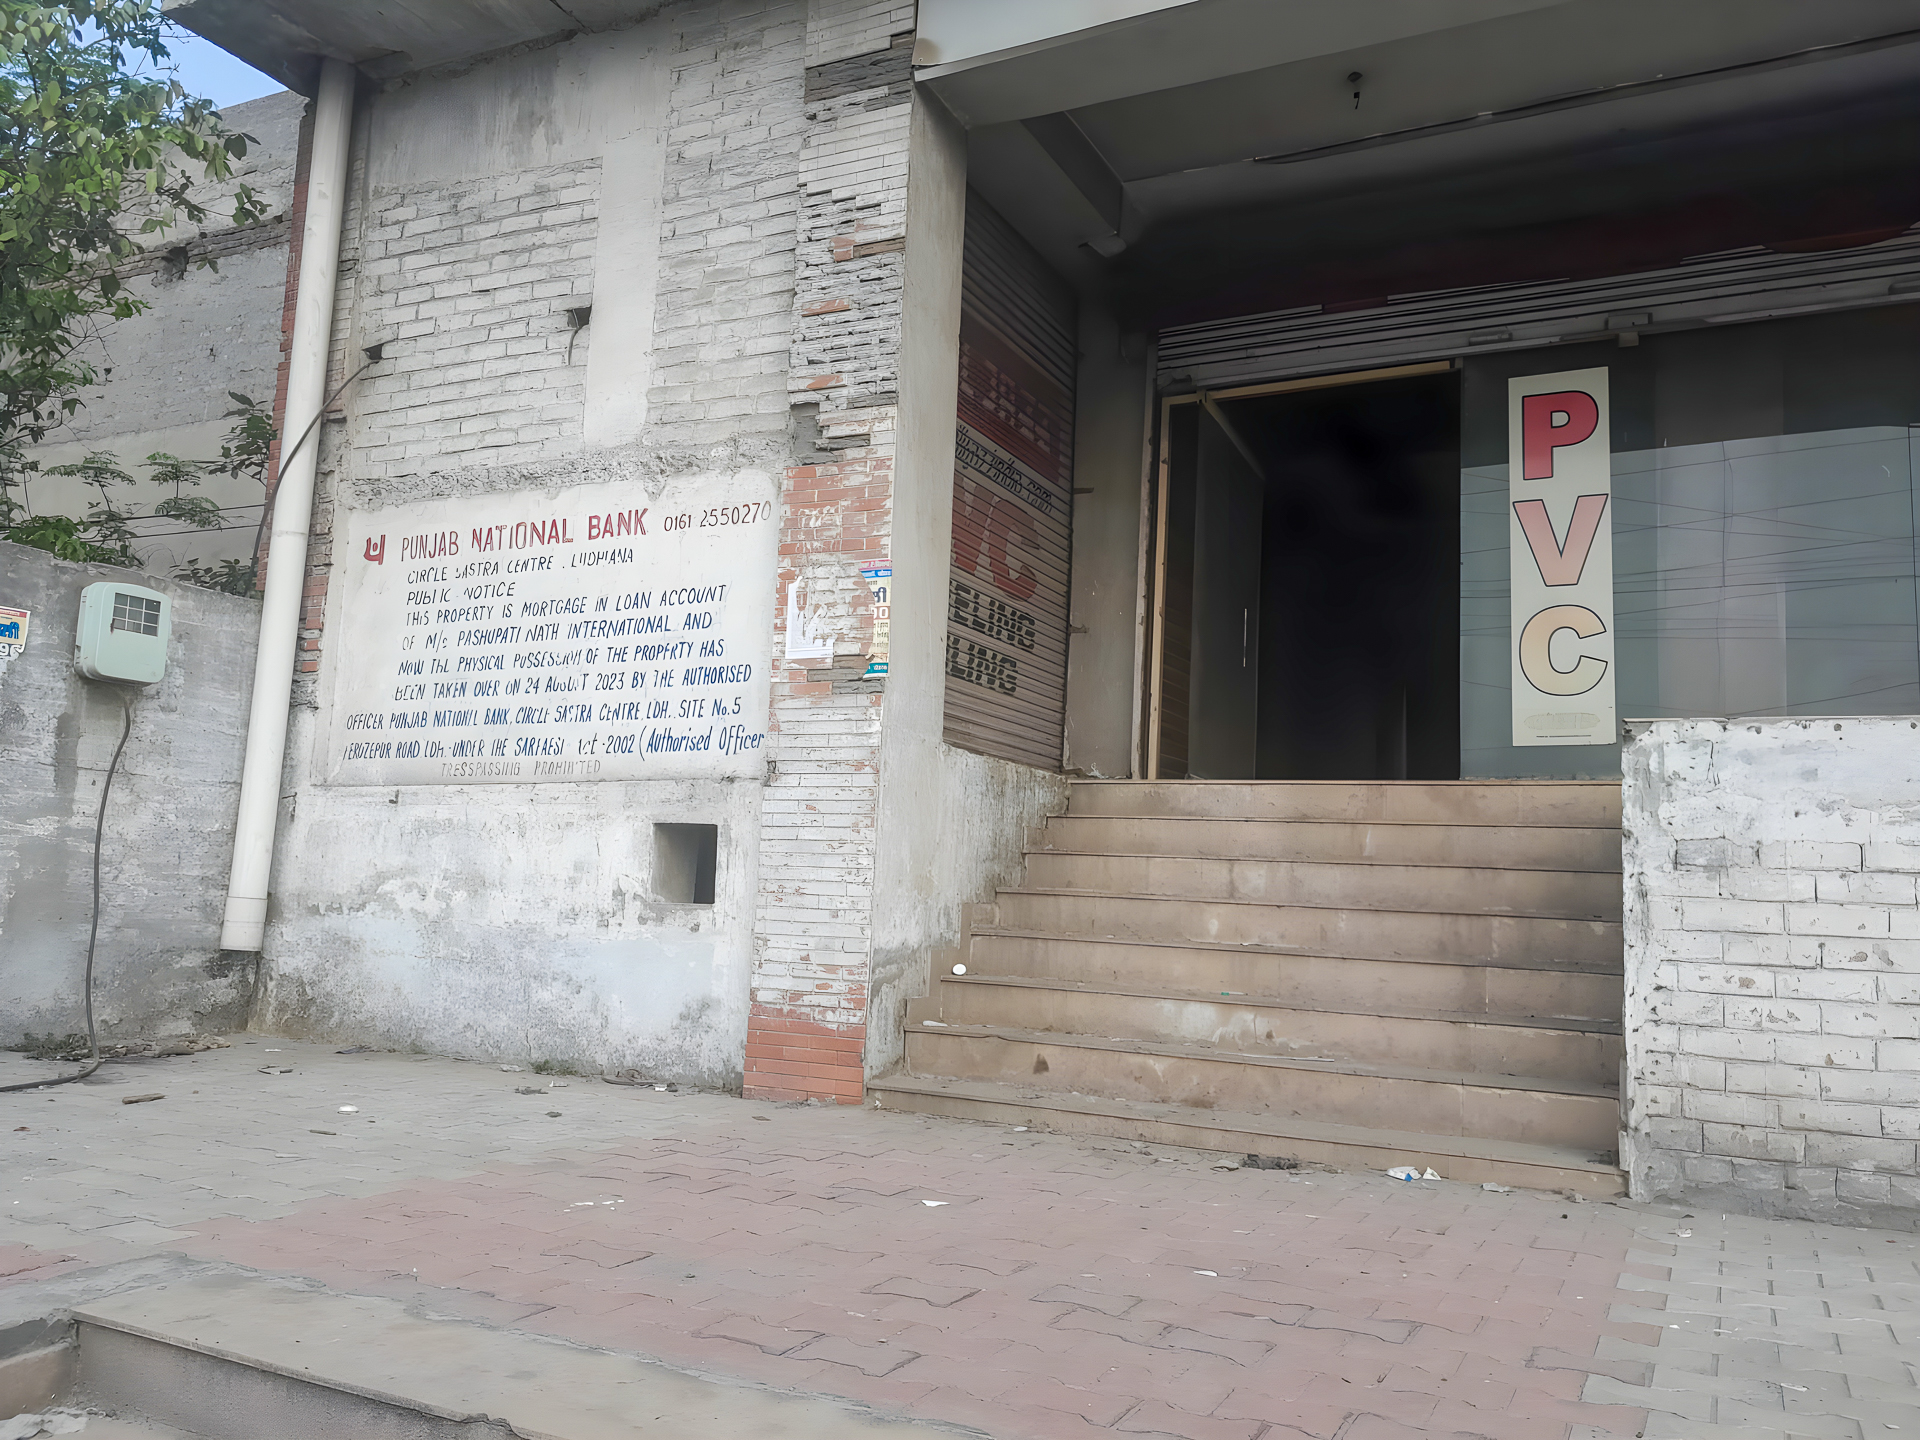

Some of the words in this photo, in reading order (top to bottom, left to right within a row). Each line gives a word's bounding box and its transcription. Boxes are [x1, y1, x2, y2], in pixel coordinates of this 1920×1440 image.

[401, 531, 459, 562] PUNJAB
[472, 518, 573, 552] NATIONAL
[588, 508, 648, 541] BANK
[664, 514, 692, 532] 0161
[700, 500, 772, 528] 2550270
[407, 567, 447, 584] CIRCLE
[507, 555, 554, 574] CENTRE
[407, 611, 429, 626] THIS
[437, 605, 494, 623] PROPERTY
[502, 603, 513, 618] IS
[521, 597, 587, 618] MORTGAGE
[595, 597, 608, 612] IN
[616, 592, 652, 612] LOAN
[659, 584, 726, 606] ACCOUNT
[464, 582, 515, 600] NOTICE
[402, 635, 415, 650] OF
[457, 626, 521, 646] PASHUPATI
[525, 623, 560, 642] NATH
[568, 615, 671, 639] INTERNATIONAL
[683, 612, 712, 630] AND
[398, 659, 424, 675] NOW
[457, 655, 505, 672] PHYSICAL
[586, 647, 599, 664] OF
[607, 646, 628, 662] THE
[634, 641, 693, 661] PROPERTY
[700, 639, 724, 657] HAS
[434, 682, 467, 698] TAKEN
[474, 680, 500, 697] OVER
[505, 678, 521, 695] ON
[525, 677, 540, 694] 24
[595, 671, 625, 690] 2023
[631, 671, 646, 688] BY
[654, 669, 674, 688] THE
[682, 664, 751, 686] AUTHORISED
[346, 713, 384, 730] OFFICER
[389, 711, 427, 729] PUNJAB
[679, 699, 705, 718] SITE
[396, 740, 419, 758] ROAD
